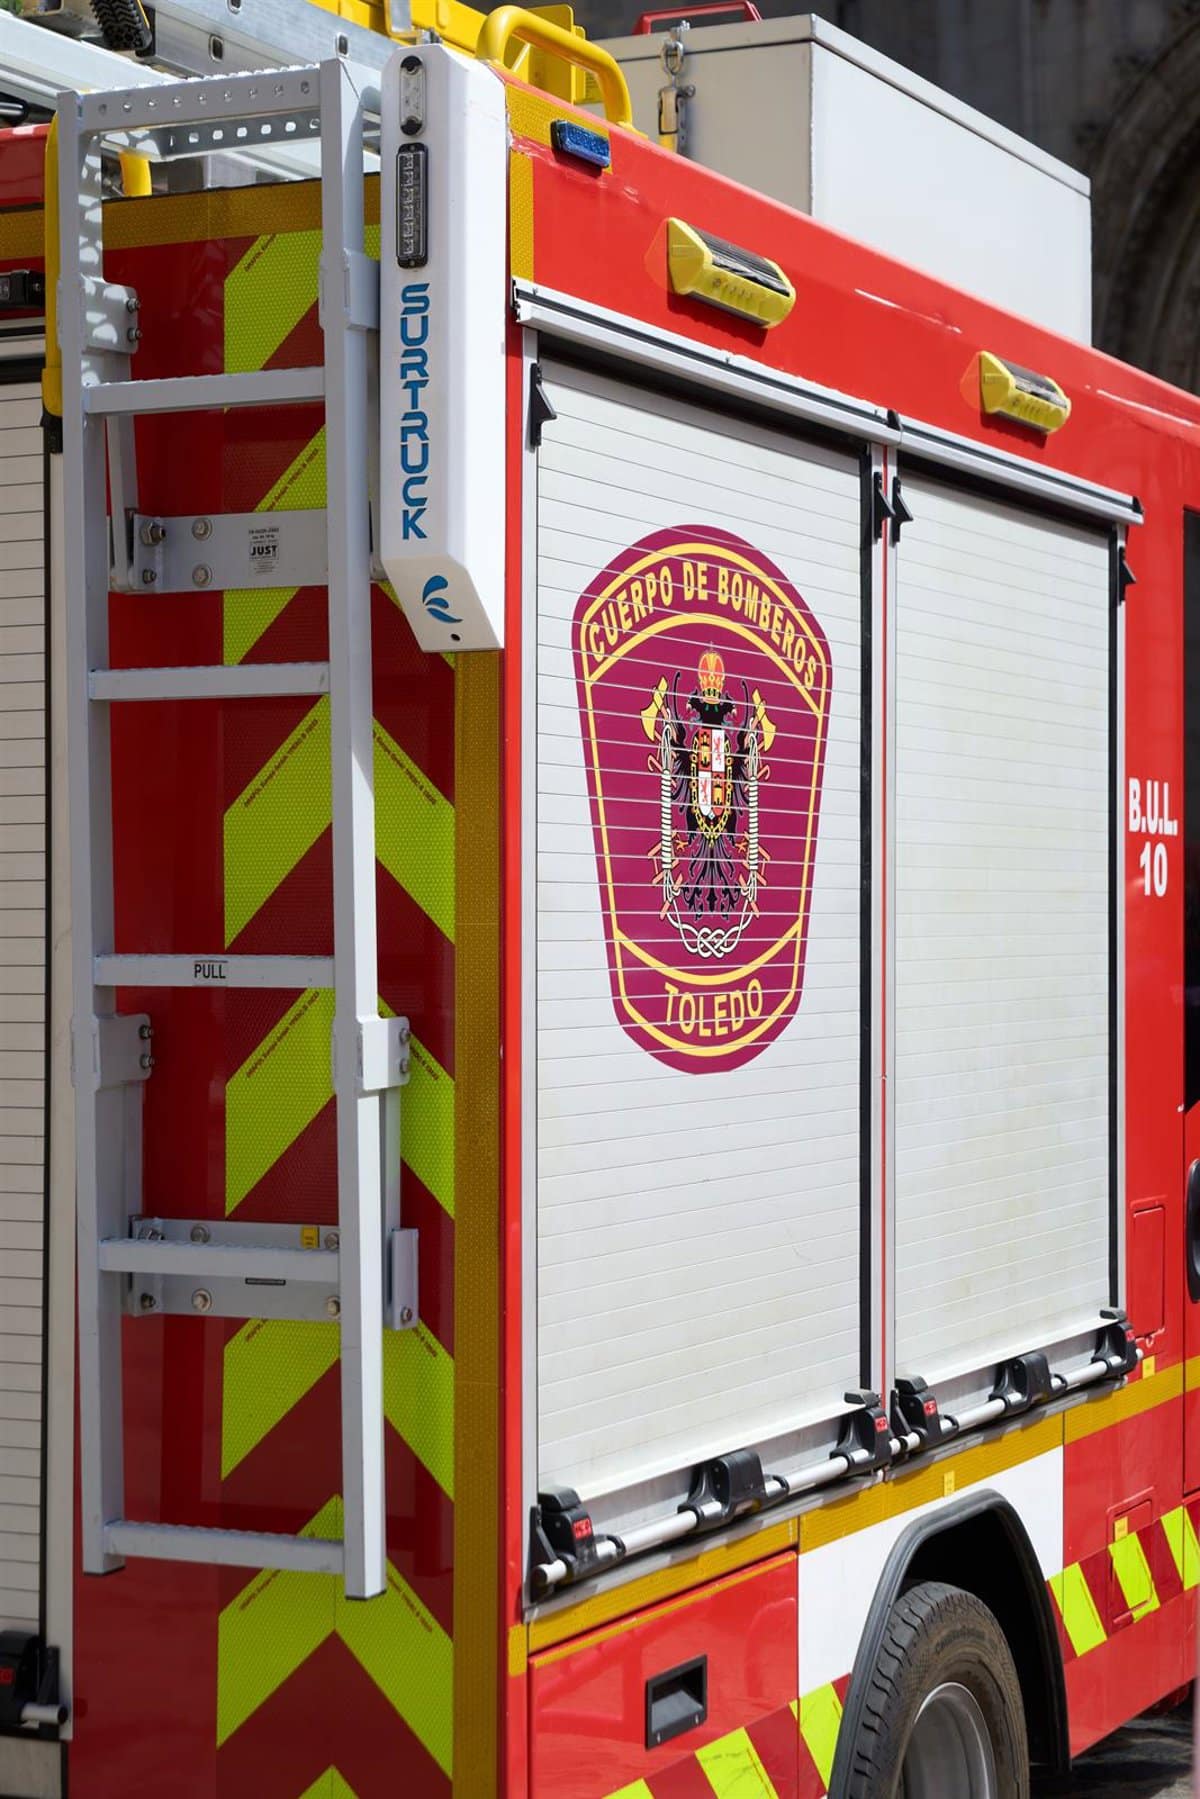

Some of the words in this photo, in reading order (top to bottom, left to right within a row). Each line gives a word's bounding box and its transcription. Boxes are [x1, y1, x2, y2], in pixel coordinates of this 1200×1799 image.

[400, 283, 430, 540] SURTRUCK
[250, 545, 277, 556] JUST
[589, 566, 673, 662] CUERPO
[683, 561, 708, 601] DE
[718, 566, 817, 690] BOMBEROS
[1129, 777, 1178, 836] B.U.L.
[1139, 841, 1168, 897] 10
[194, 963, 226, 979] PULL
[665, 978, 763, 1037] TOLEDO
